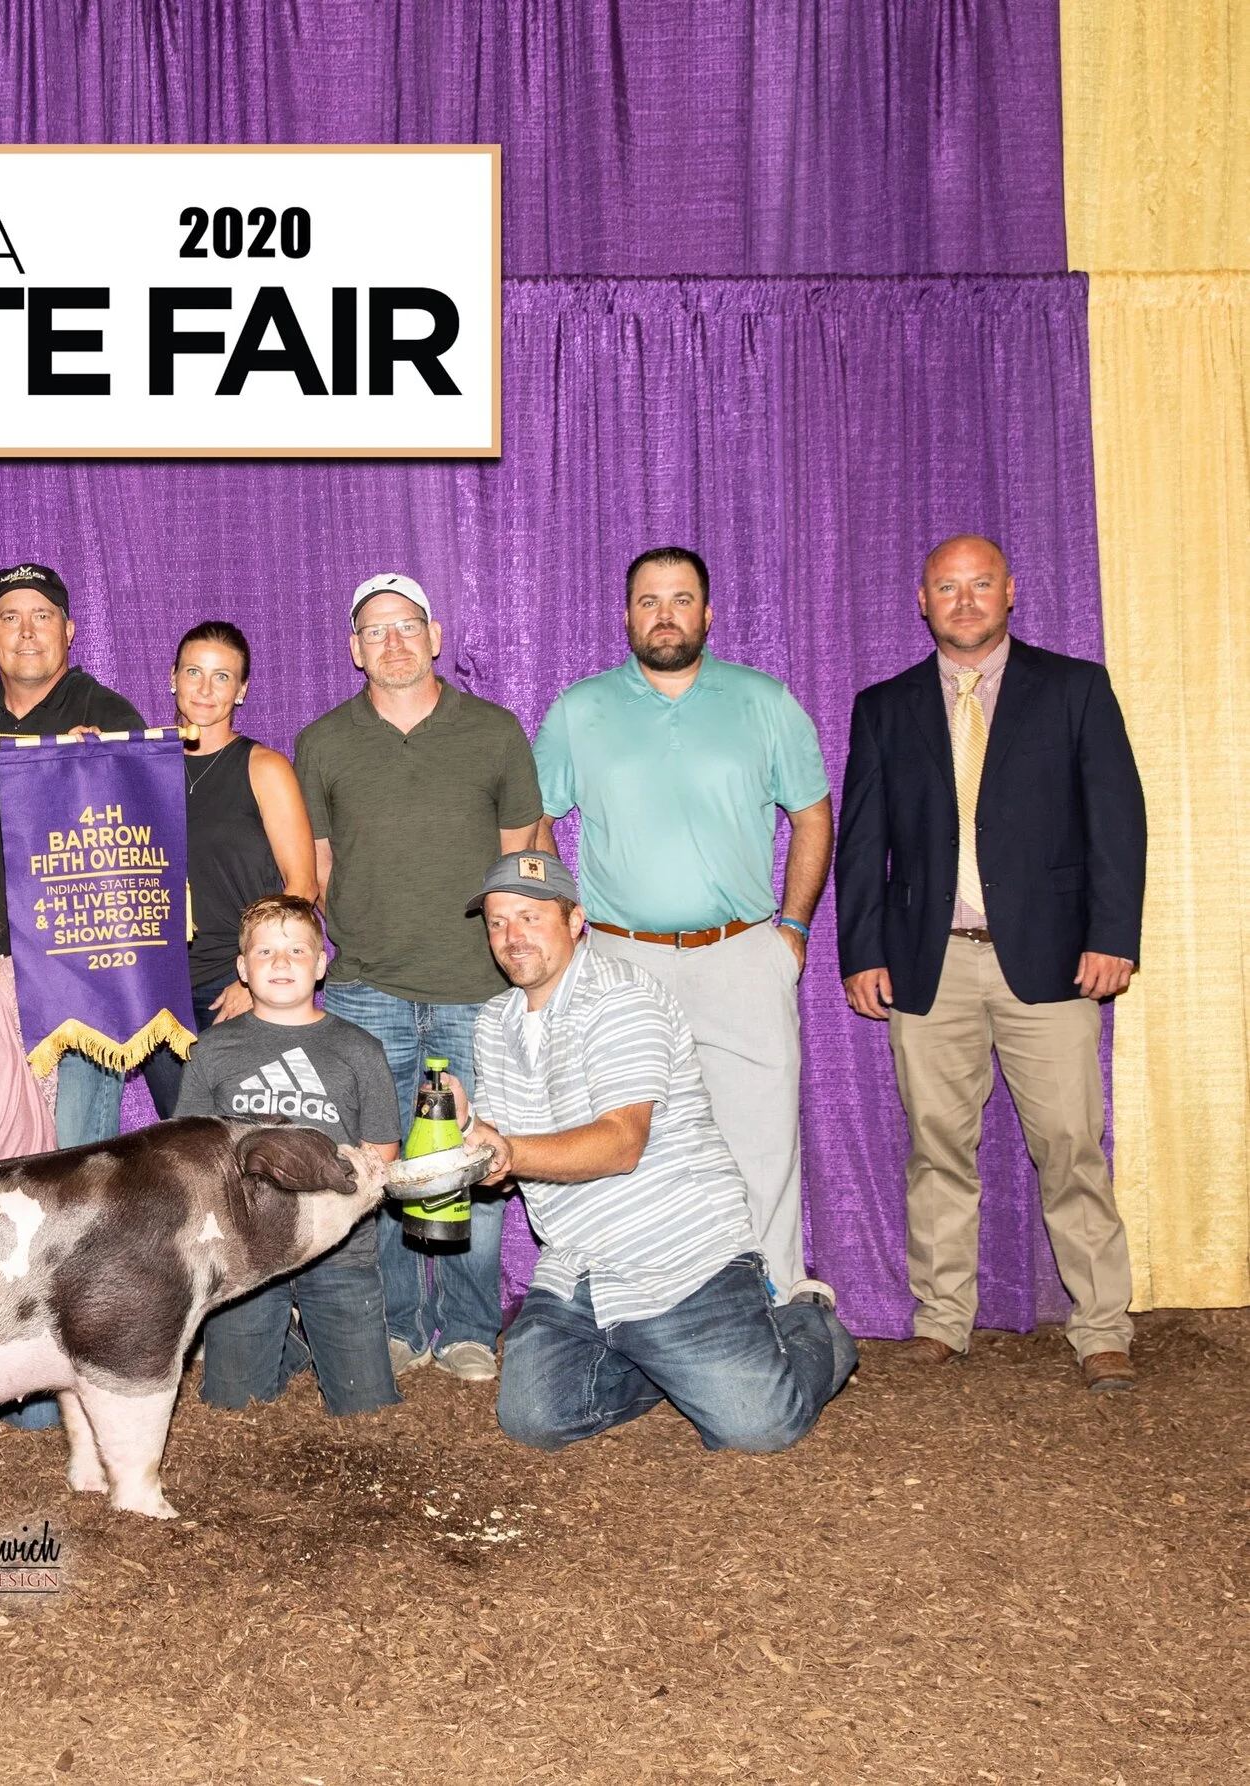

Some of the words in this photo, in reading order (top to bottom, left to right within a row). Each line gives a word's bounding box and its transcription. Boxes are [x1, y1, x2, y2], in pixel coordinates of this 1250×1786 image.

[79, 804, 123, 826] 4-H
[49, 826, 151, 852] BARROW
[30, 851, 85, 876] FIFTH
[90, 847, 169, 870] OVERALL
[46, 881, 97, 896] INDIANA
[100, 878, 136, 890] STATE
[138, 878, 160, 888] FAIR
[33, 896, 68, 913] 4-H
[73, 889, 171, 910] LIVESTOCK
[35, 915, 49, 930] &
[54, 911, 88, 928] 4-H
[93, 905, 171, 925] PROJECT
[54, 922, 161, 945] SHOWCASE
[88, 951, 137, 970] 2020
[232, 1089, 340, 1124] adidas
